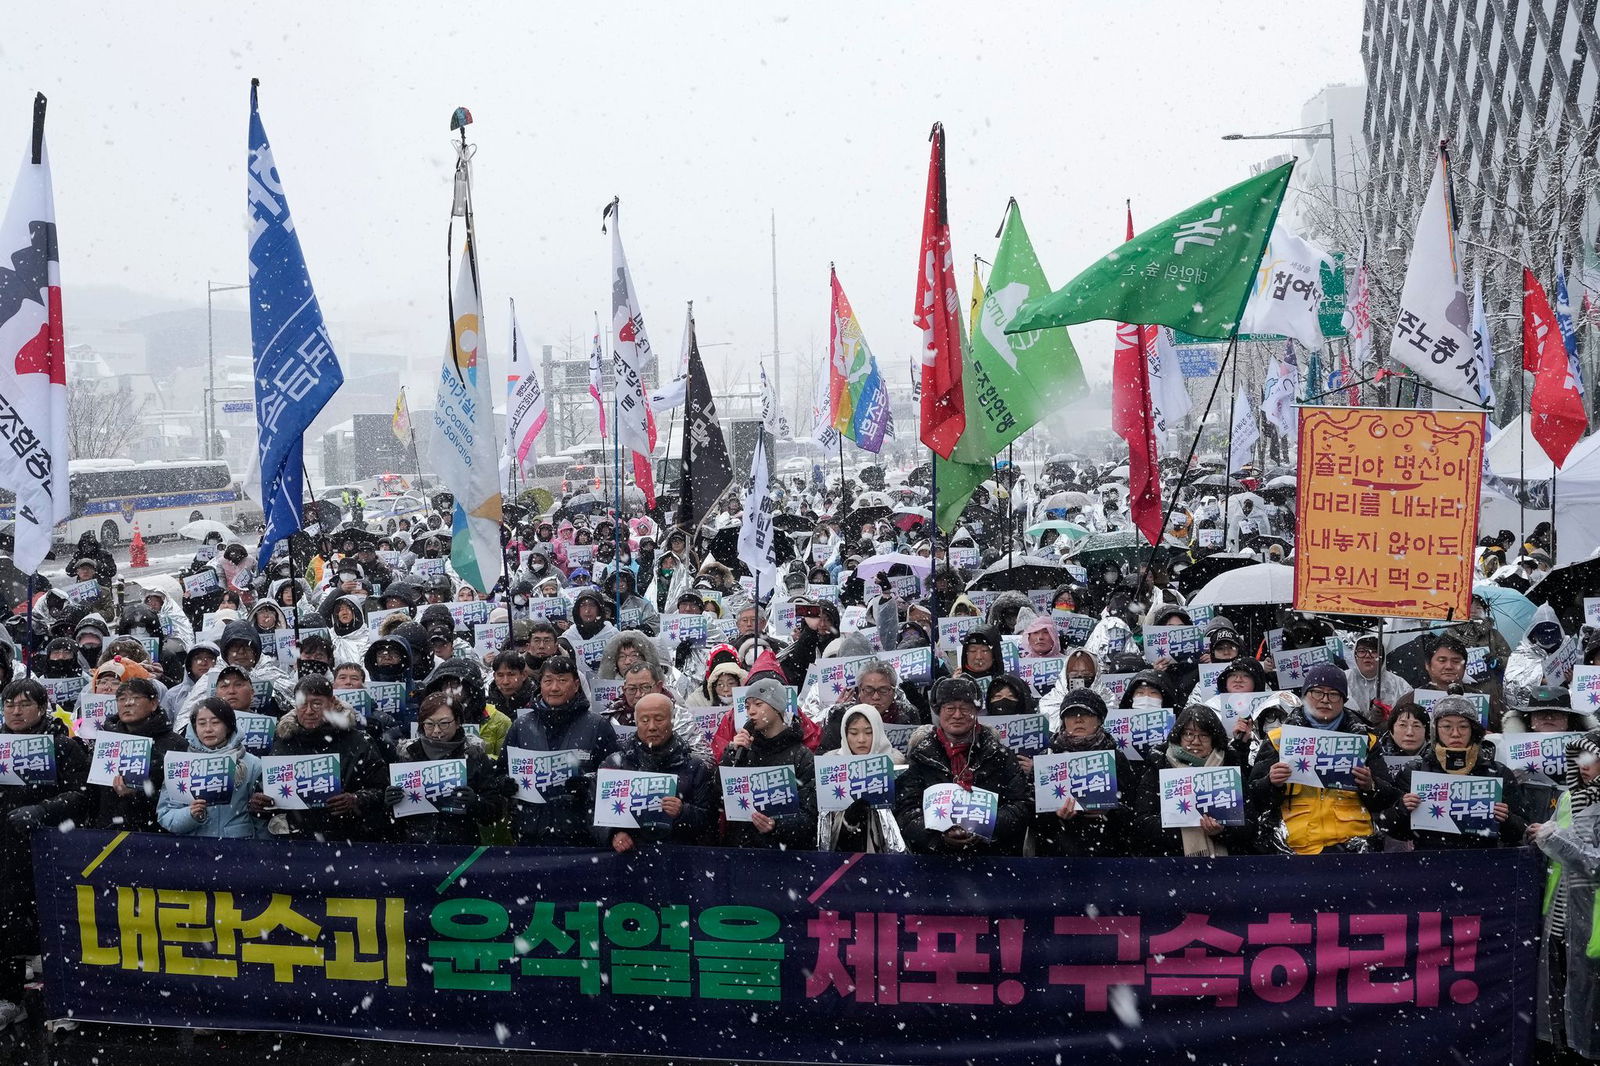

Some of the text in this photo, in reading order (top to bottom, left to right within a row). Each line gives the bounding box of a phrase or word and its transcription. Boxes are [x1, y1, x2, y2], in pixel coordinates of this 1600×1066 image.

[1397, 308, 1460, 365] 주노총
[1315, 453, 1466, 481] 쥴리야 명신아
[1313, 492, 1462, 519] 머리를 내놔라
[1311, 529, 1458, 556] 내놓지 않아도
[1311, 566, 1457, 593] 구워서 먹으리
[464, 612, 485, 624] 구속!
[679, 616, 705, 629] 체포!
[1070, 617, 1093, 630] 체포!
[680, 628, 703, 640] 구속!
[1147, 632, 1168, 641] 내란수괴
[1168, 628, 1202, 645] 체포!
[1147, 638, 1168, 648] 윤석열
[1170, 642, 1202, 656] 구속!
[901, 650, 927, 665] 체포!
[820, 664, 844, 676] 내란수괴
[900, 664, 927, 680] 구속!
[1033, 658, 1062, 673] 체포!
[1279, 661, 1300, 672] 윤석열
[1465, 662, 1487, 678] 하라
[820, 670, 844, 683] 윤석열
[595, 686, 617, 696] 내란수괴
[595, 692, 617, 702] 윤석열
[84, 702, 104, 712] 내란수괴
[85, 708, 104, 719] 윤석열
[1007, 718, 1044, 737] 체포!
[1129, 712, 1168, 732] 체포!
[11, 738, 50, 758] 체포!
[98, 741, 121, 752] 내란수괴
[120, 739, 148, 758] 체포!
[1008, 733, 1044, 751] 구속!
[1285, 737, 1316, 749] 내란수괴
[1315, 736, 1362, 756] 체포!
[1509, 740, 1540, 754] 내란동조
[97, 748, 120, 759] 윤석열
[1284, 744, 1316, 756] 윤석열
[1510, 748, 1541, 761] 국민의힘
[12, 755, 50, 775] 구속!
[119, 756, 147, 776] 구속!
[167, 760, 190, 771] 내란수괴
[189, 756, 230, 776] 체포!
[266, 763, 294, 775] 내란수괴
[293, 754, 334, 779] 체포!
[512, 757, 534, 767] 내란수괴
[533, 751, 573, 774] 체포!
[847, 755, 889, 780] 체포!
[1068, 753, 1109, 778] 체포!
[1315, 755, 1359, 775] 구속!
[167, 768, 190, 781] 윤석열
[394, 769, 421, 783] 내란수괴
[421, 760, 461, 785] 체포!
[512, 764, 534, 776] 윤석열
[819, 764, 847, 776] 내란수괴
[190, 773, 230, 795] 구속!
[267, 771, 294, 785] 윤석열
[601, 778, 630, 790] 내란수괴
[630, 775, 670, 796] 체포!
[725, 776, 749, 787] 내란수괴
[750, 766, 790, 791] 체포!
[820, 773, 848, 786] 윤석열
[1040, 771, 1068, 786] 윤석열
[1164, 775, 1192, 789] 내란수괴
[1192, 768, 1235, 792] 체포!
[296, 775, 335, 798] 구속!
[601, 787, 630, 799] 윤석열
[725, 783, 749, 796] 윤석열
[849, 778, 889, 800] 구속!
[1070, 775, 1110, 798] 구속!
[1164, 785, 1192, 800] 윤석열
[1416, 782, 1449, 793] 내란수괴
[1450, 779, 1496, 801] 체포!
[752, 787, 793, 811] 구속!
[924, 797, 951, 809] 윤석열
[951, 787, 992, 807] 체포!
[1196, 790, 1237, 814] 구속!
[630, 796, 664, 816] 구속
[1450, 800, 1495, 821] 구속!
[952, 804, 991, 825] 구속!
[76, 884, 1482, 1013] 내란수괴 윤석열을 체포! 구속하라!
